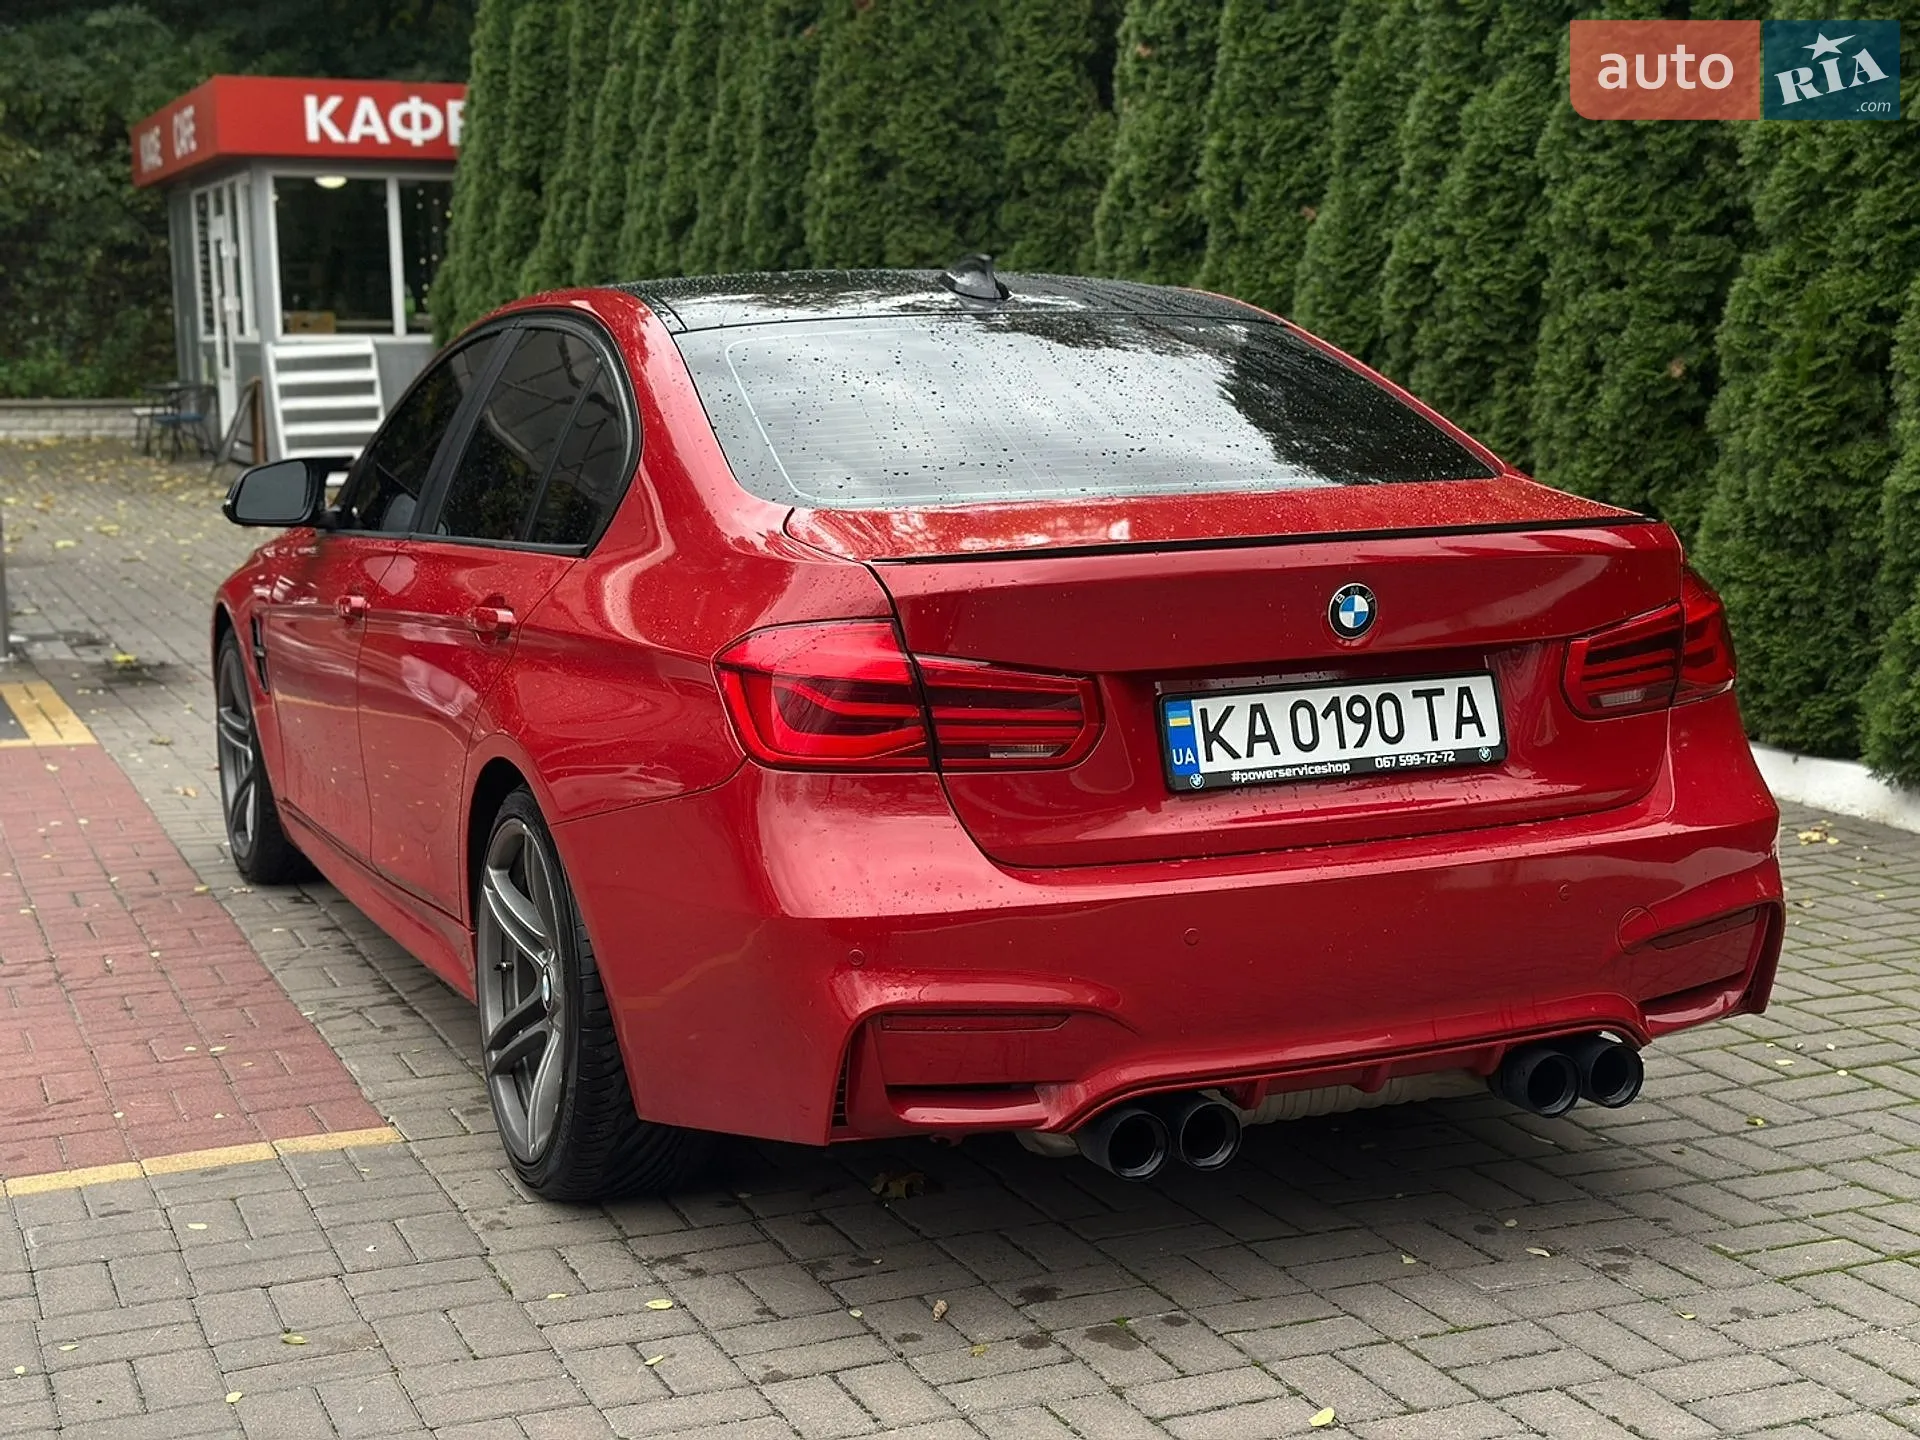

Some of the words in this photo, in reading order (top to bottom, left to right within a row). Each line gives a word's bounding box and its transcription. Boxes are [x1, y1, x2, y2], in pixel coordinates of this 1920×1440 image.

[1200, 703, 1281, 762] KA
[1289, 692, 1405, 752] 0190
[1411, 686, 1487, 742] TA
[1172, 747, 1196, 766] UA
[1375, 756, 1396, 769] 067
[1399, 751, 1456, 767] 599-72-72
[1230, 762, 1351, 783] #powerserviceshop
